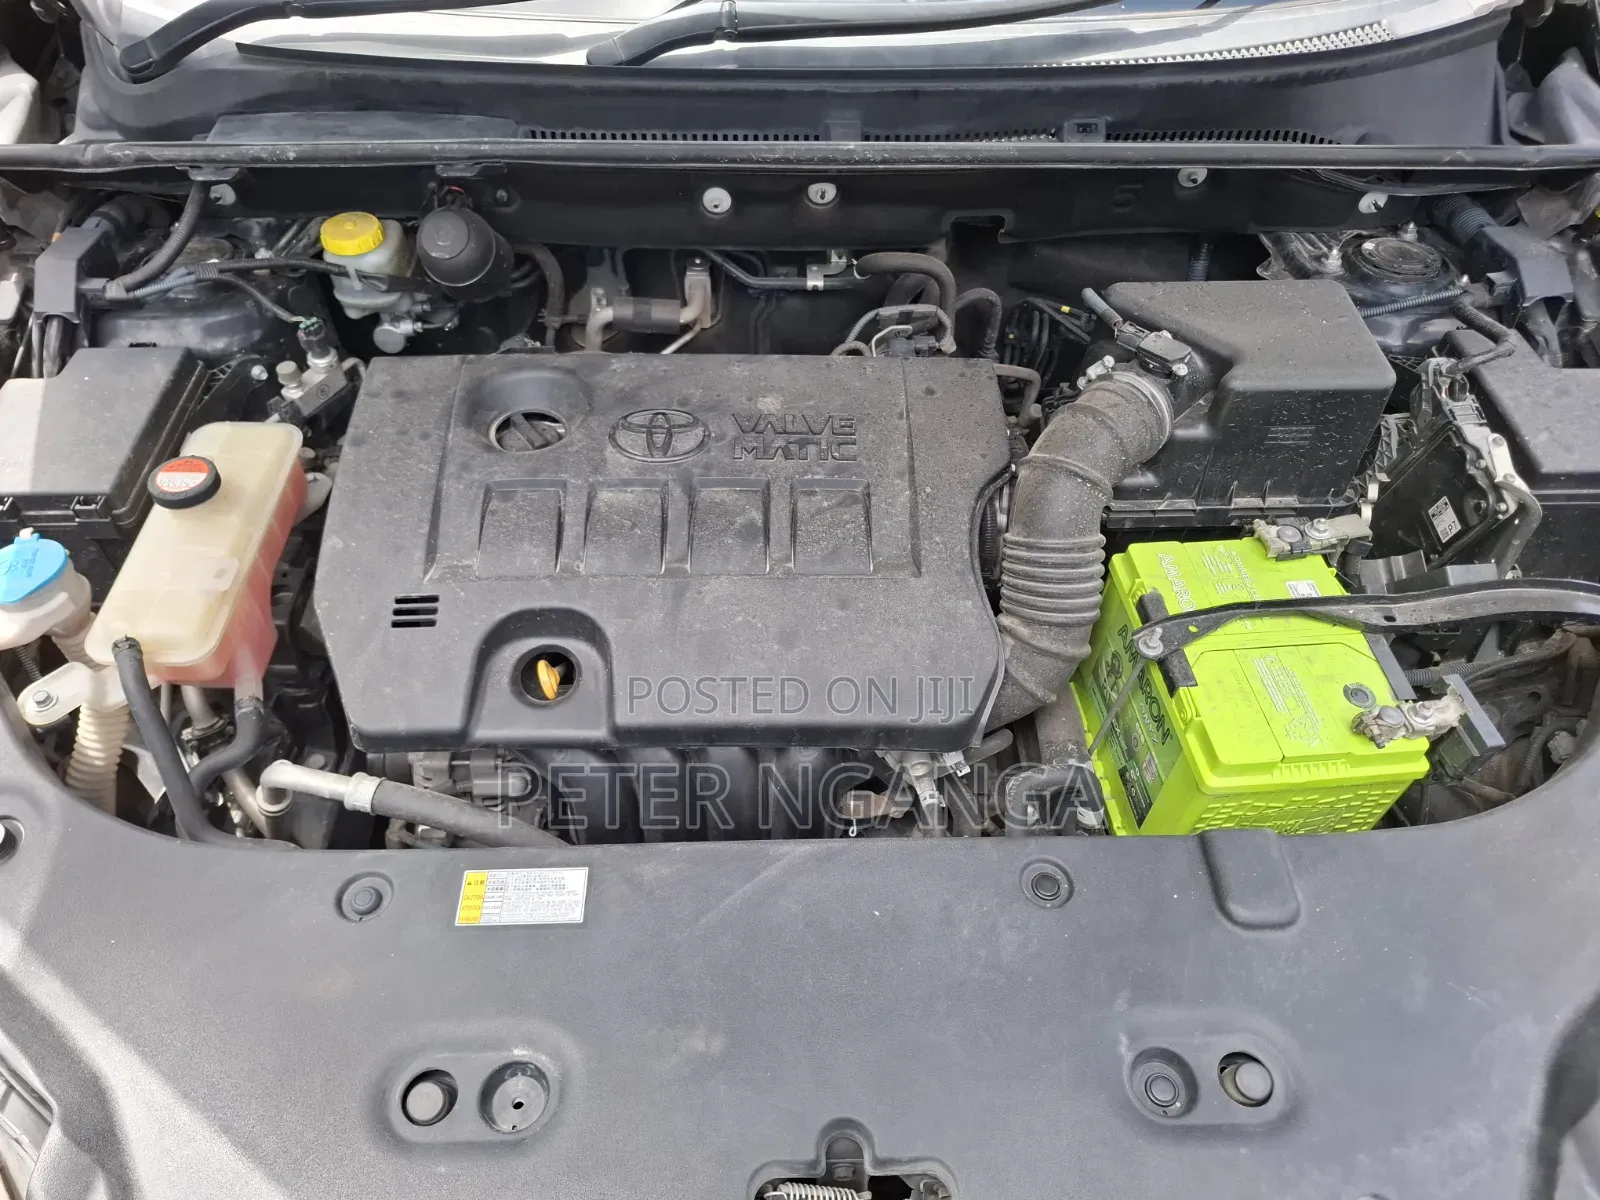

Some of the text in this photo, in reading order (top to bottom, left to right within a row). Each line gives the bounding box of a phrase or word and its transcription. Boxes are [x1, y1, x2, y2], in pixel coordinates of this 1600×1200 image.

[731, 412, 856, 437] VALVE
[732, 437, 857, 462] MATIC
[1447, 520, 1457, 534] P7
[1158, 554, 1195, 613] AMARO
